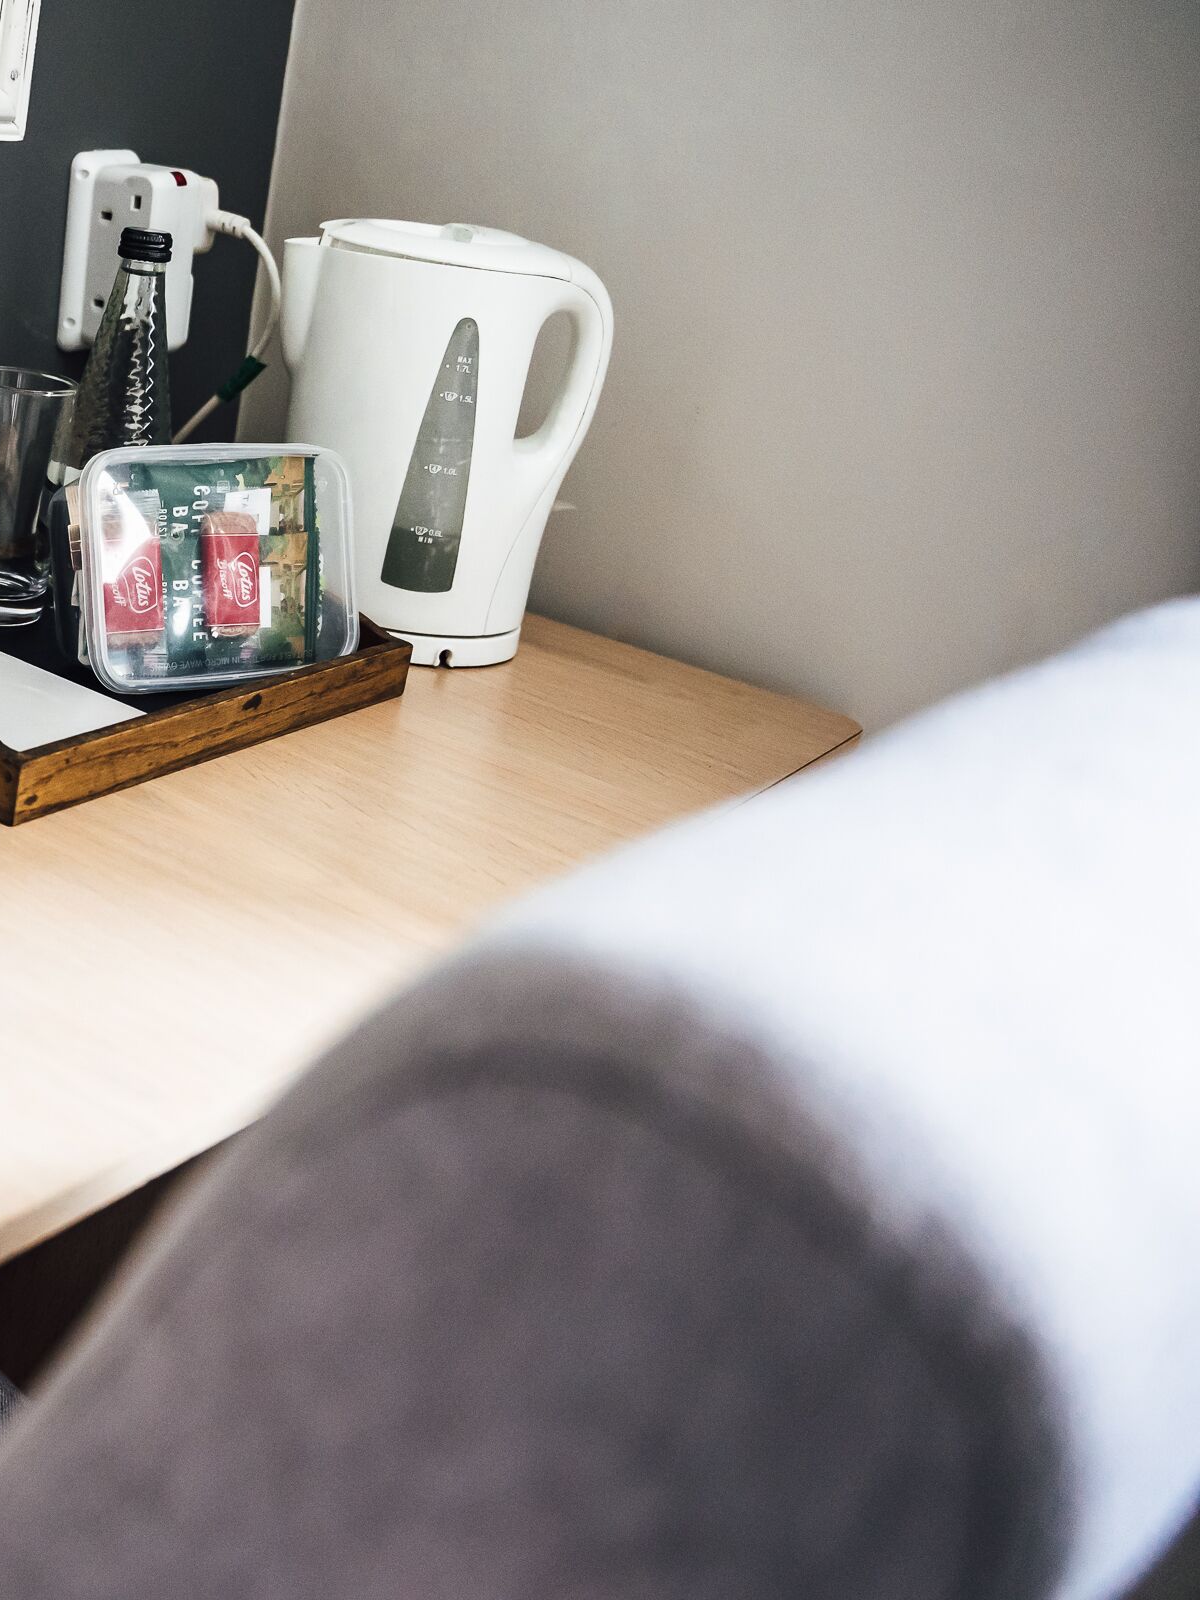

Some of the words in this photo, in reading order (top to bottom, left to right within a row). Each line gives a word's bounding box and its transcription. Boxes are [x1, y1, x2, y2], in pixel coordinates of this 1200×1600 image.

[457, 356, 472, 364] MAX
[456, 365, 471, 374] 1.7L
[459, 395, 473, 404] 1.5L
[443, 467, 457, 476] 1.0L
[217, 558, 233, 600] Biscoff
[238, 562, 255, 601] Lotus
[132, 567, 151, 607] Lotus
